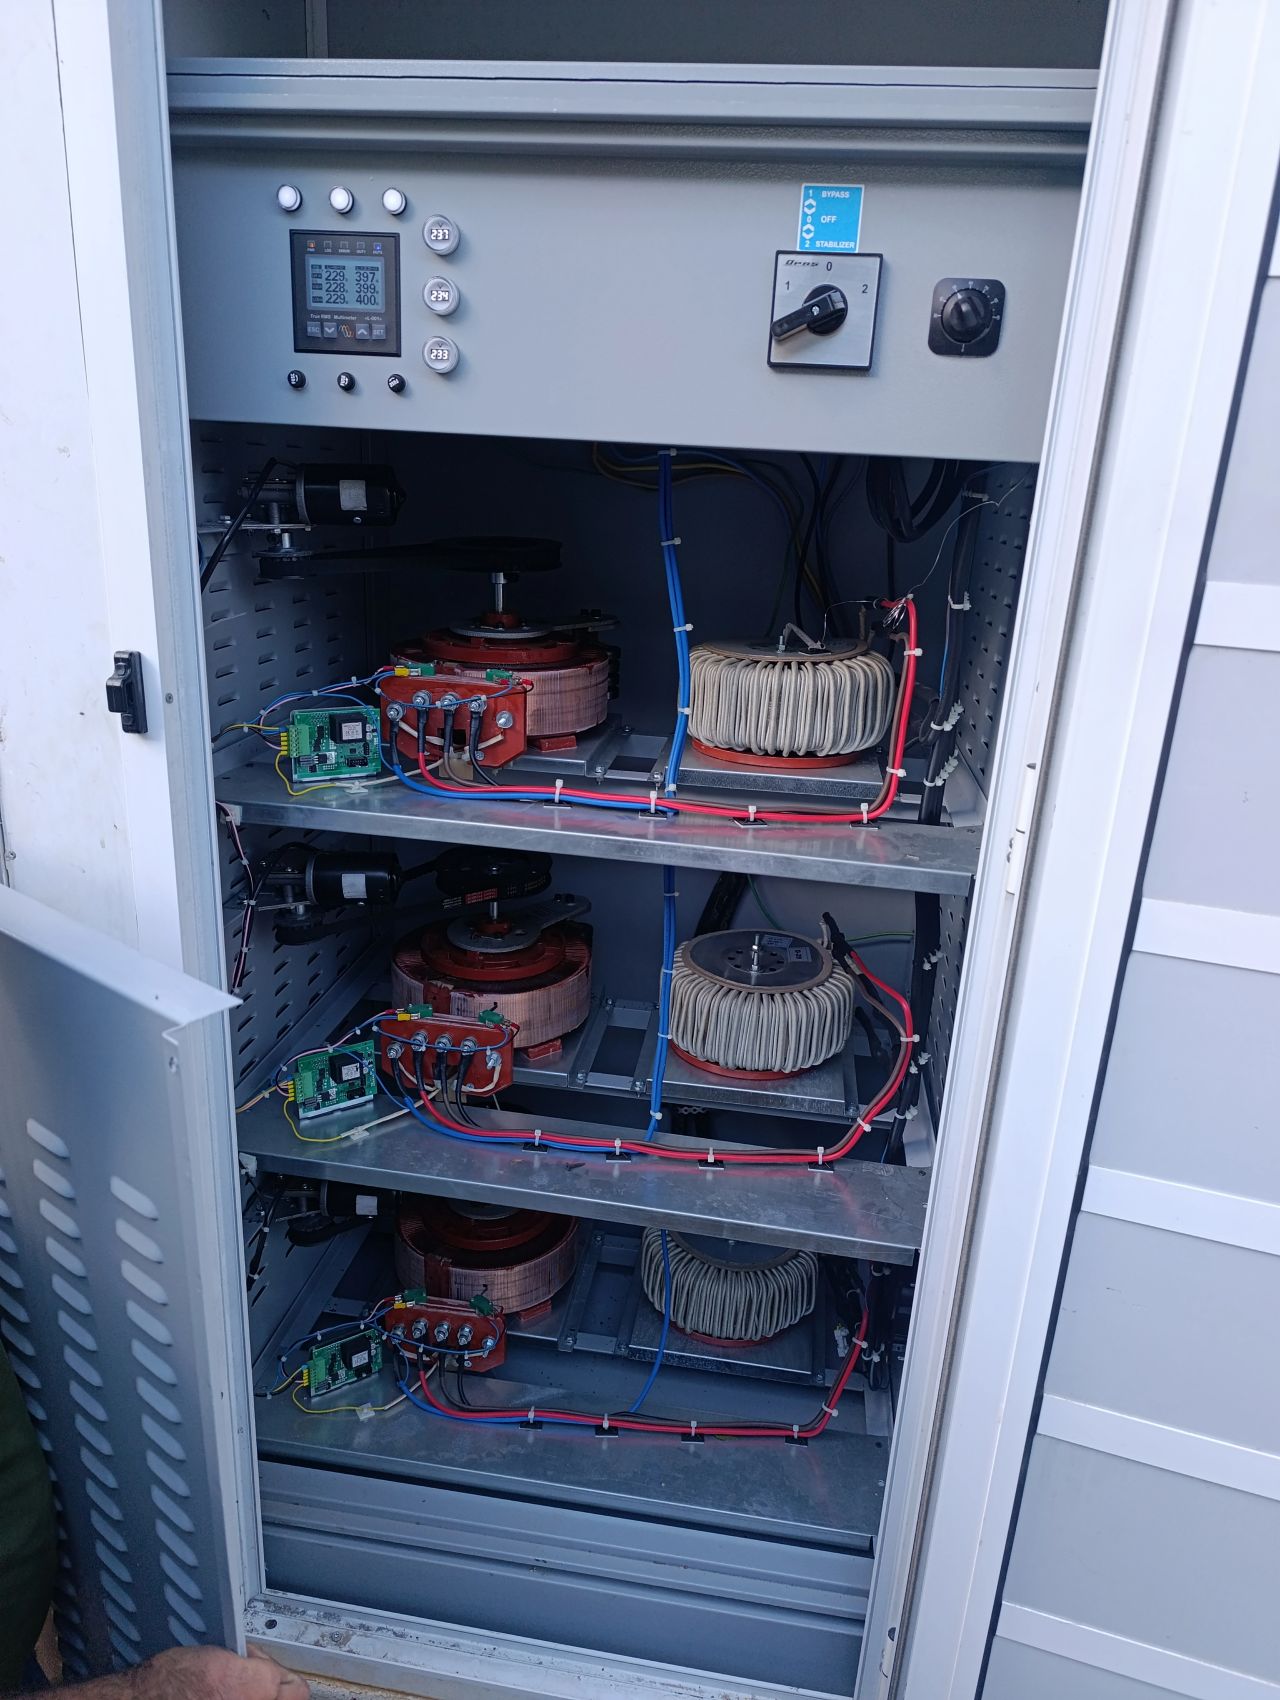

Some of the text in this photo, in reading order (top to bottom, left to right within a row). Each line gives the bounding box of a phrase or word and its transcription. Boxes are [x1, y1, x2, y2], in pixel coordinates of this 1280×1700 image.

[430, 229, 449, 240] 237
[826, 262, 832, 271] 0
[785, 280, 790, 290] 1
[862, 284, 868, 294] 2
[430, 290, 449, 301] 234
[430, 350, 448, 360] 233
